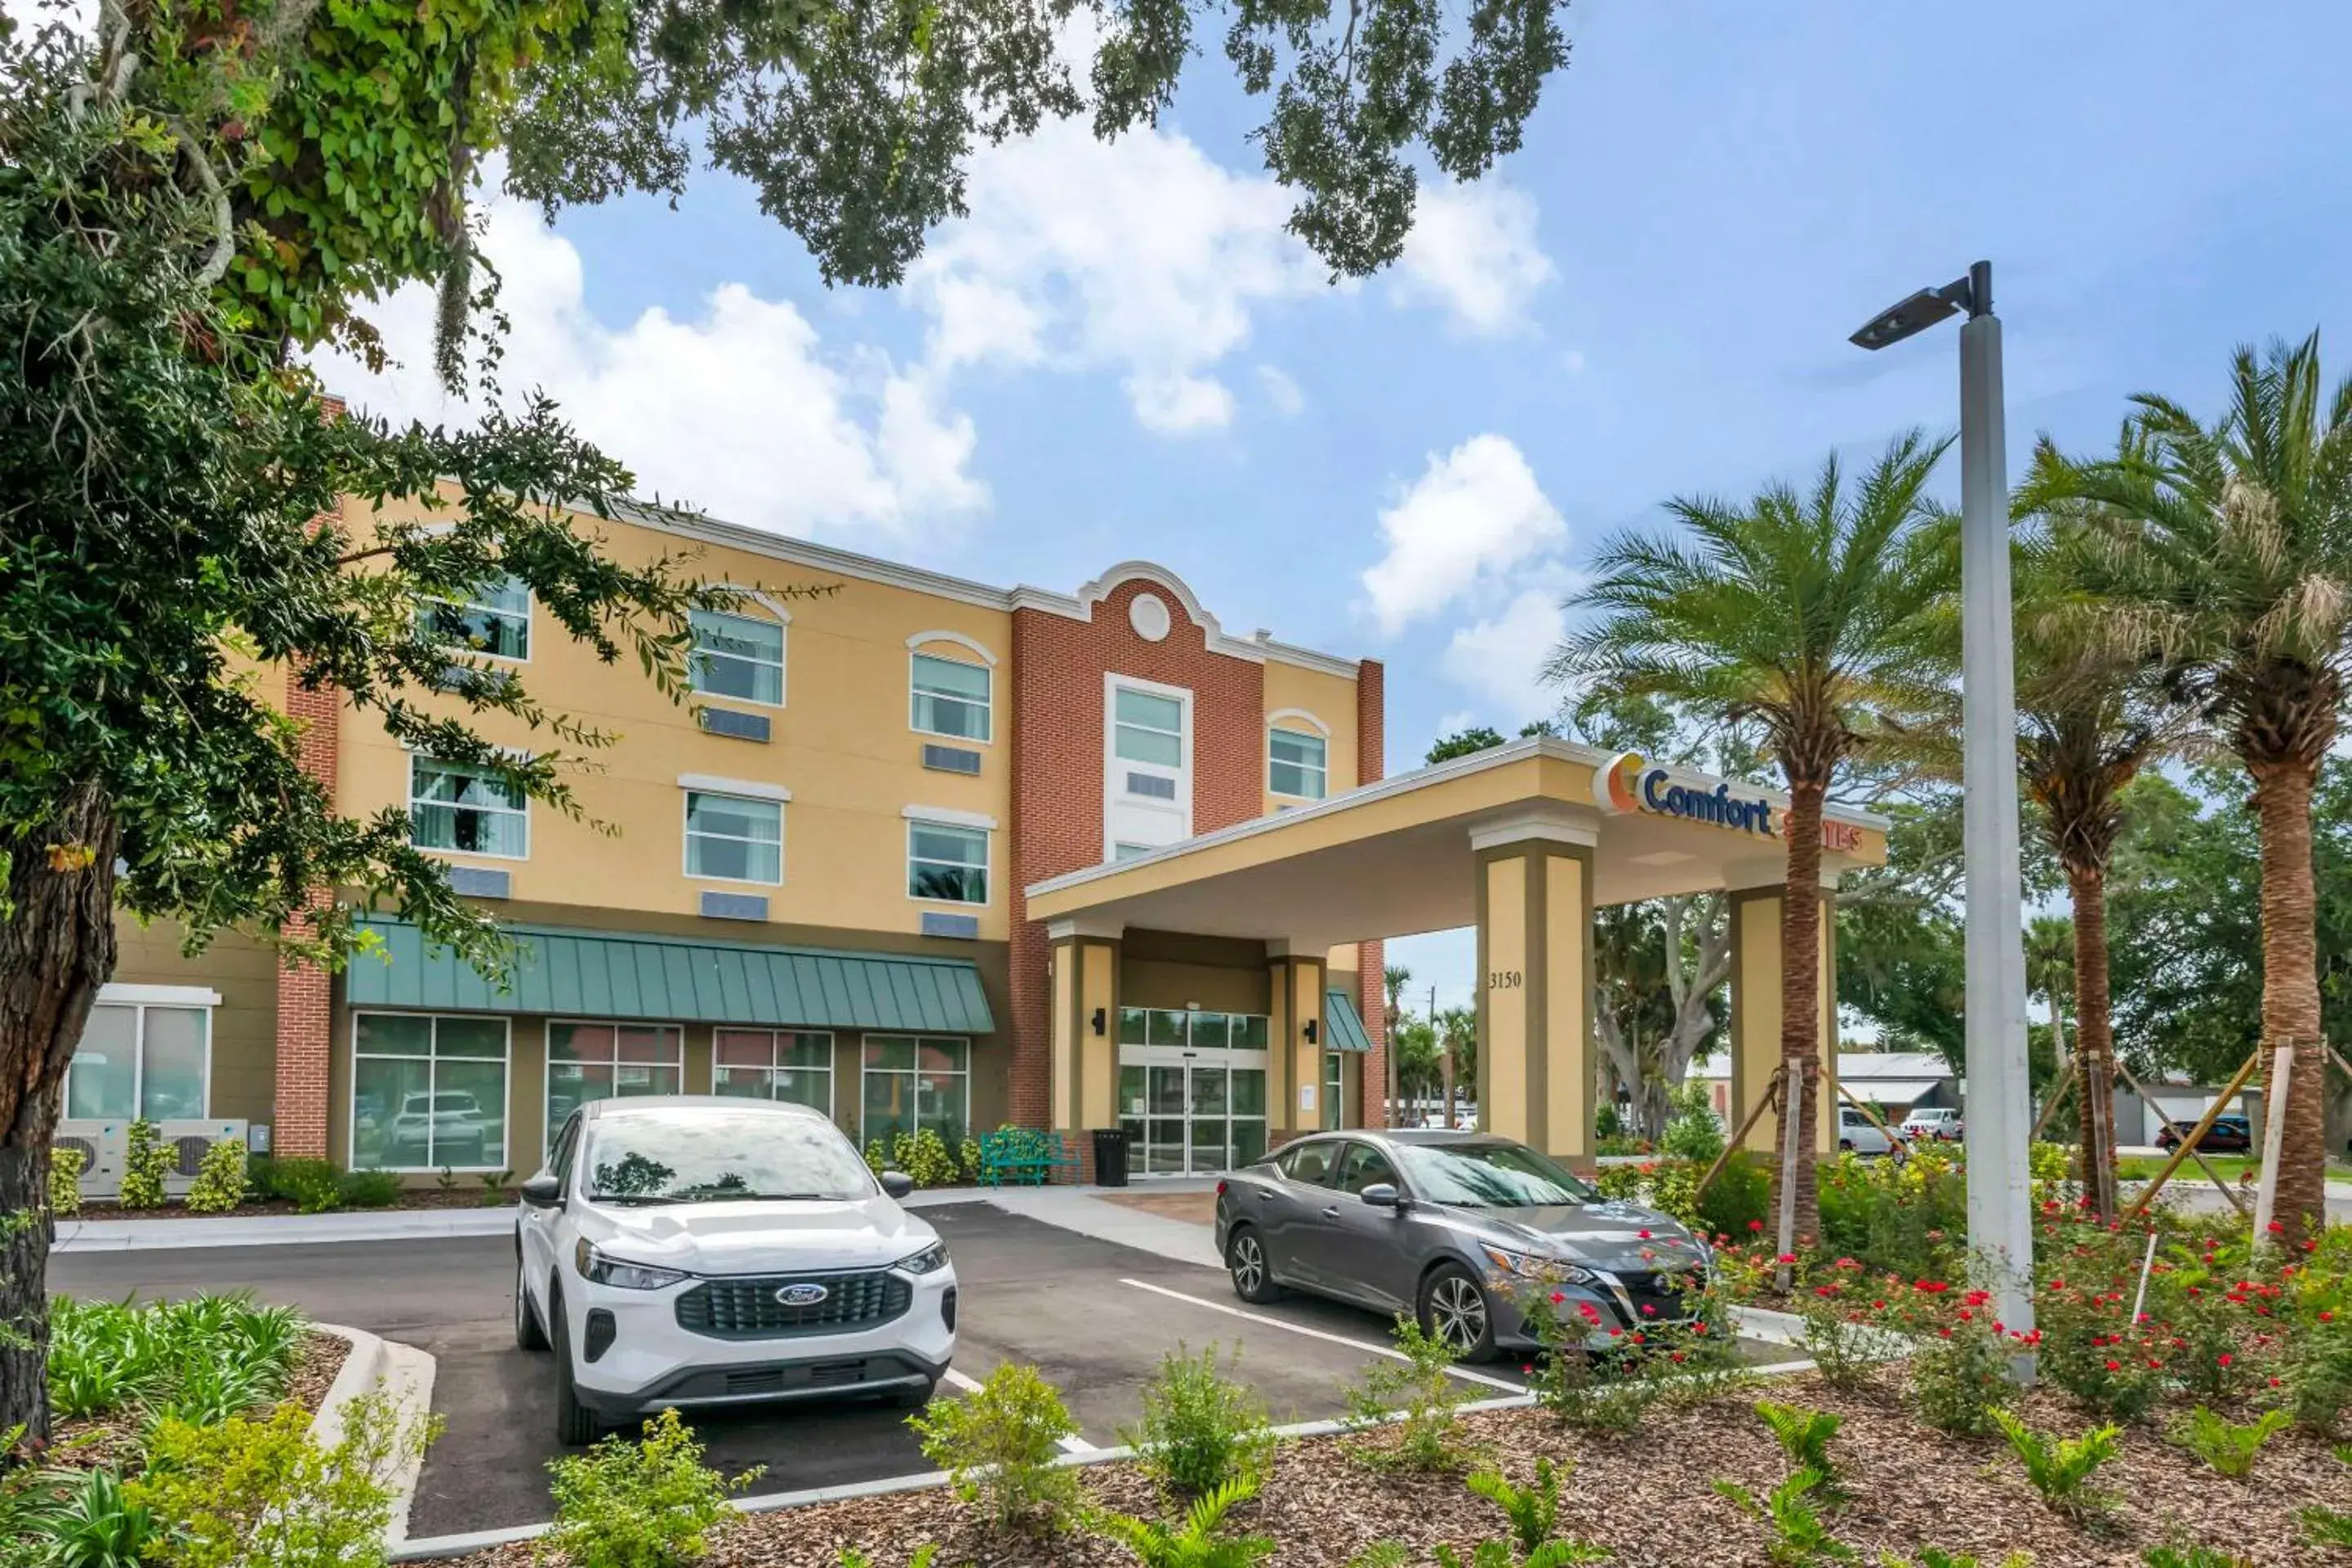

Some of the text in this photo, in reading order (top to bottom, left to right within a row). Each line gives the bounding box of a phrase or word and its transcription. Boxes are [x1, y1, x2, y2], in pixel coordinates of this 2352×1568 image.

[1643, 768, 1771, 834] Comfort
[1490, 971, 1521, 989] 3150
[785, 1288, 817, 1302] Ford
